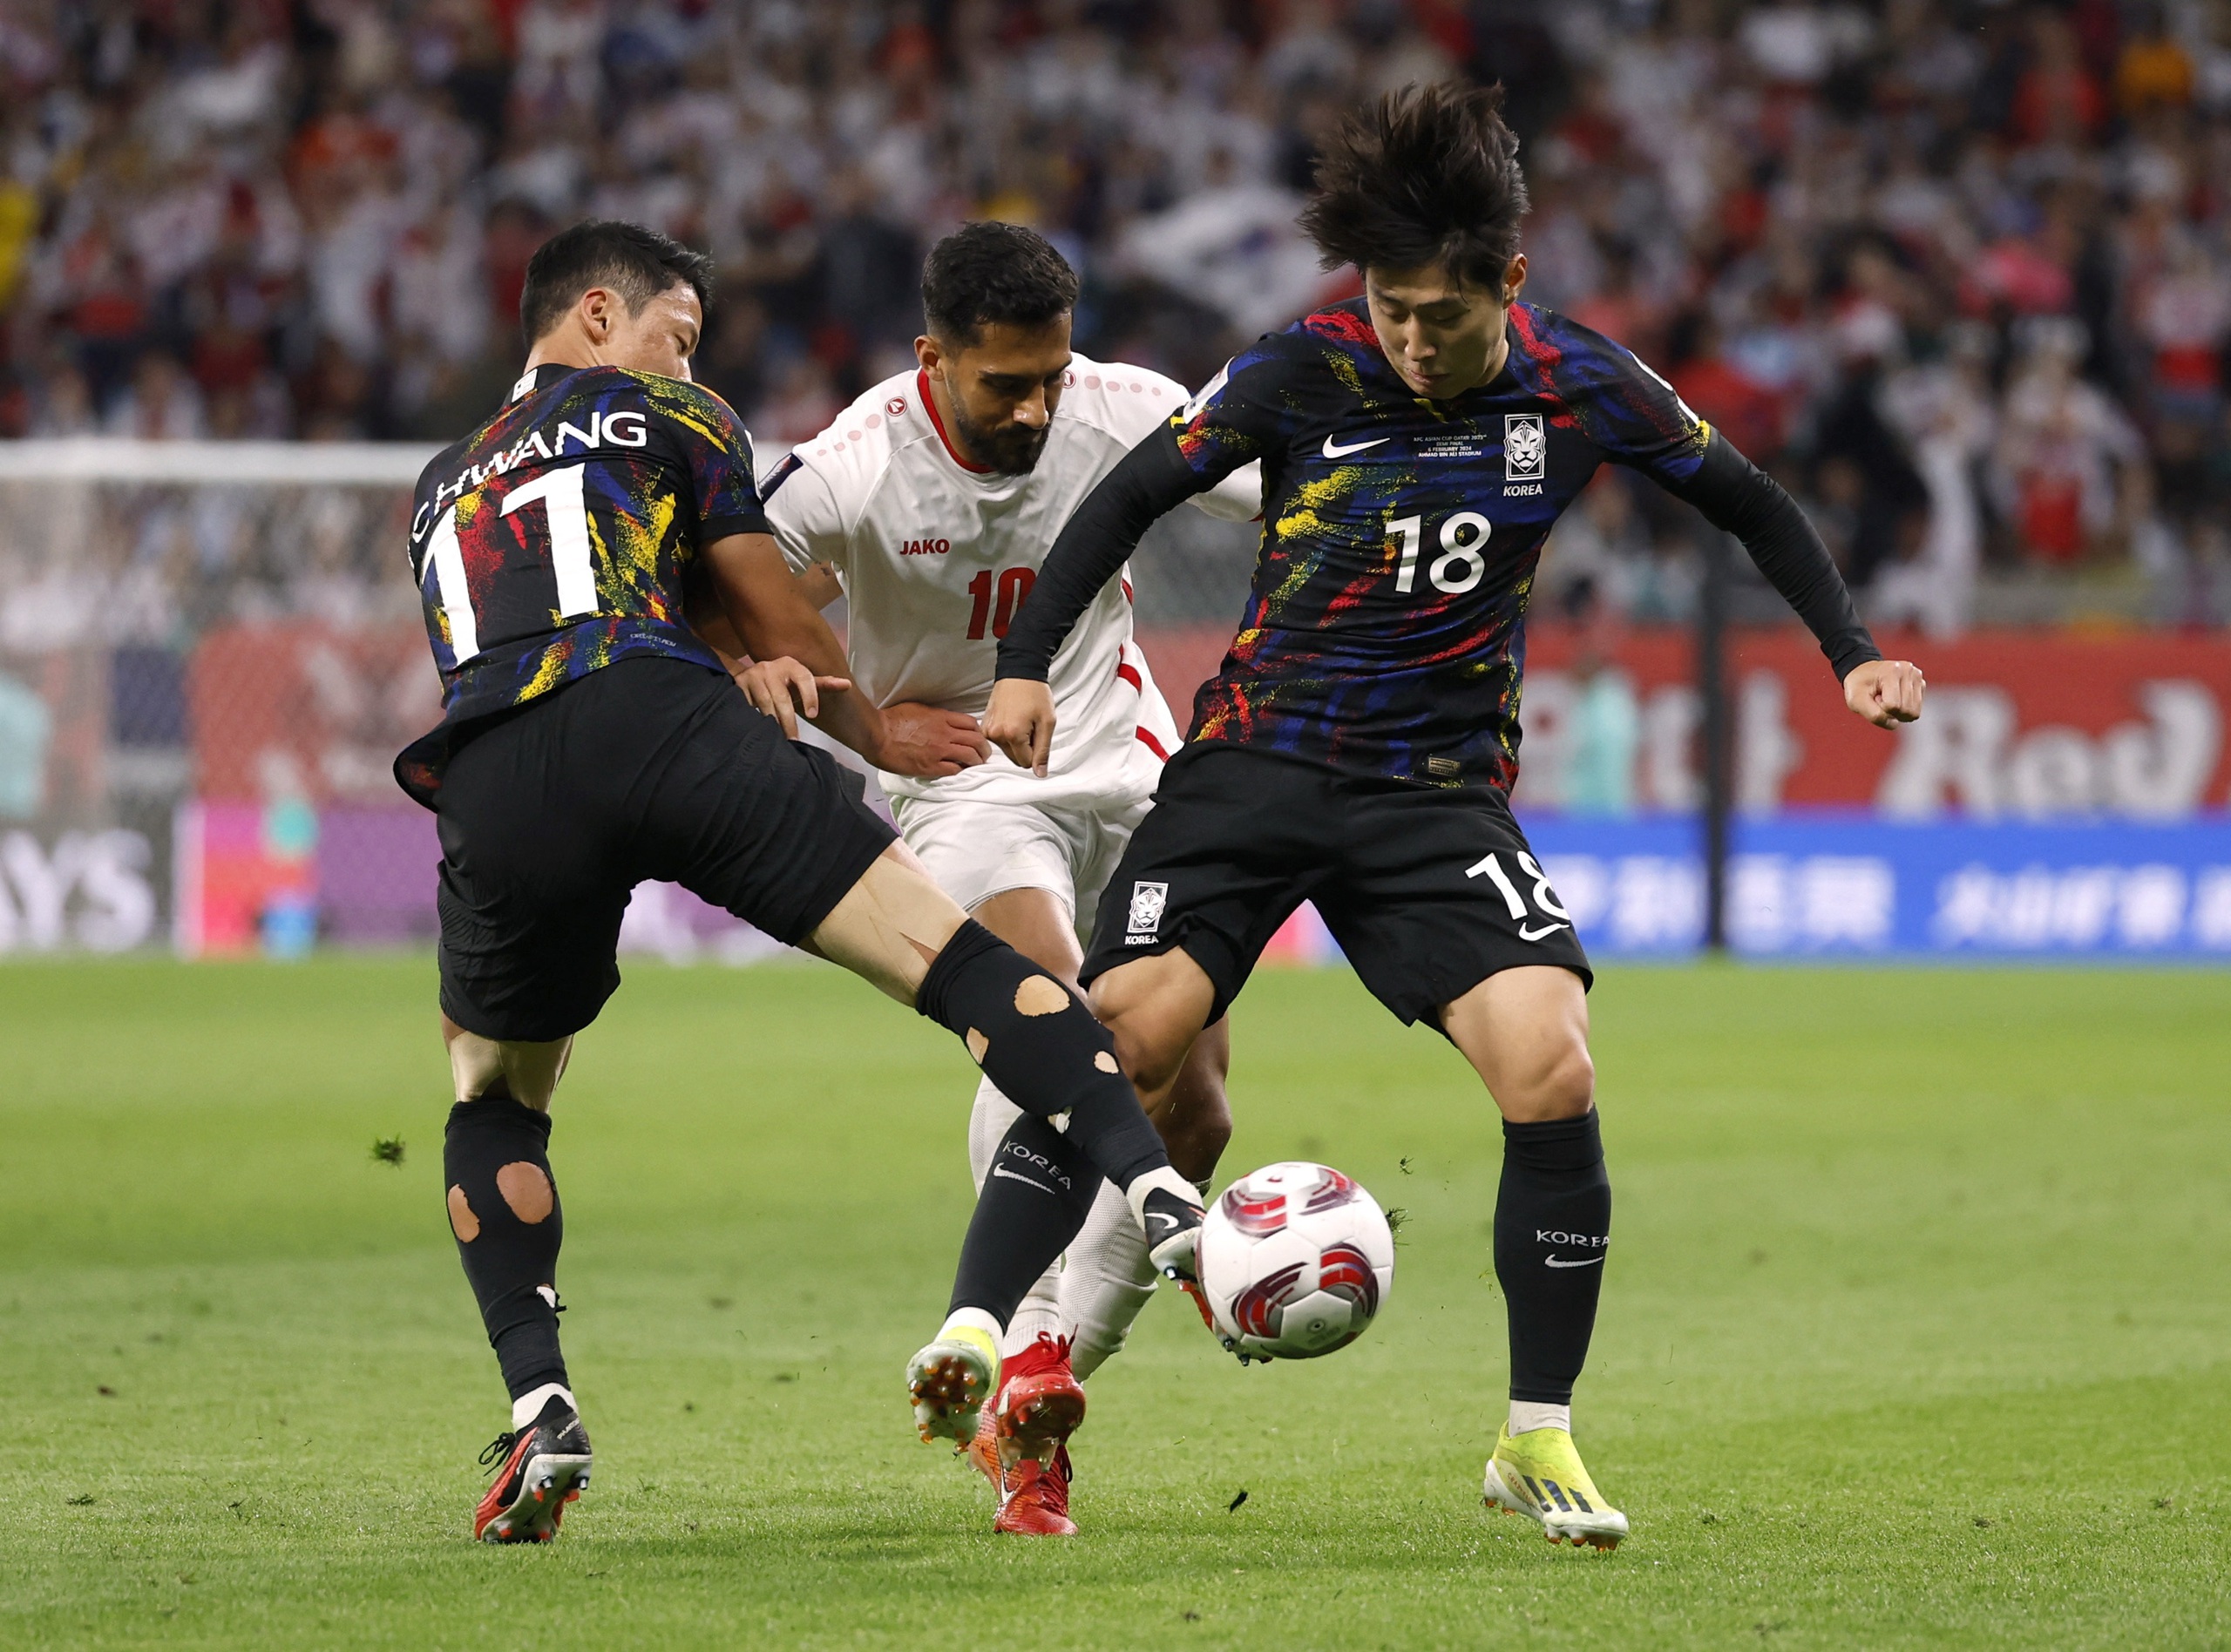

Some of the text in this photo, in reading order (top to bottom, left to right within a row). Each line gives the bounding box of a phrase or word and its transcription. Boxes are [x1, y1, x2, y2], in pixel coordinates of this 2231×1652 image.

[1502, 483, 1543, 498] KOREA
[422, 463, 600, 667] 11
[899, 538, 951, 556] JAKO
[1385, 511, 1492, 594] 18
[966, 566, 1037, 640] 10
[1464, 850, 1571, 921] 18
[1124, 935, 1160, 945] KOREA
[1001, 1140, 1072, 1191] KOREA
[1536, 1229, 1611, 1248] KOREA
